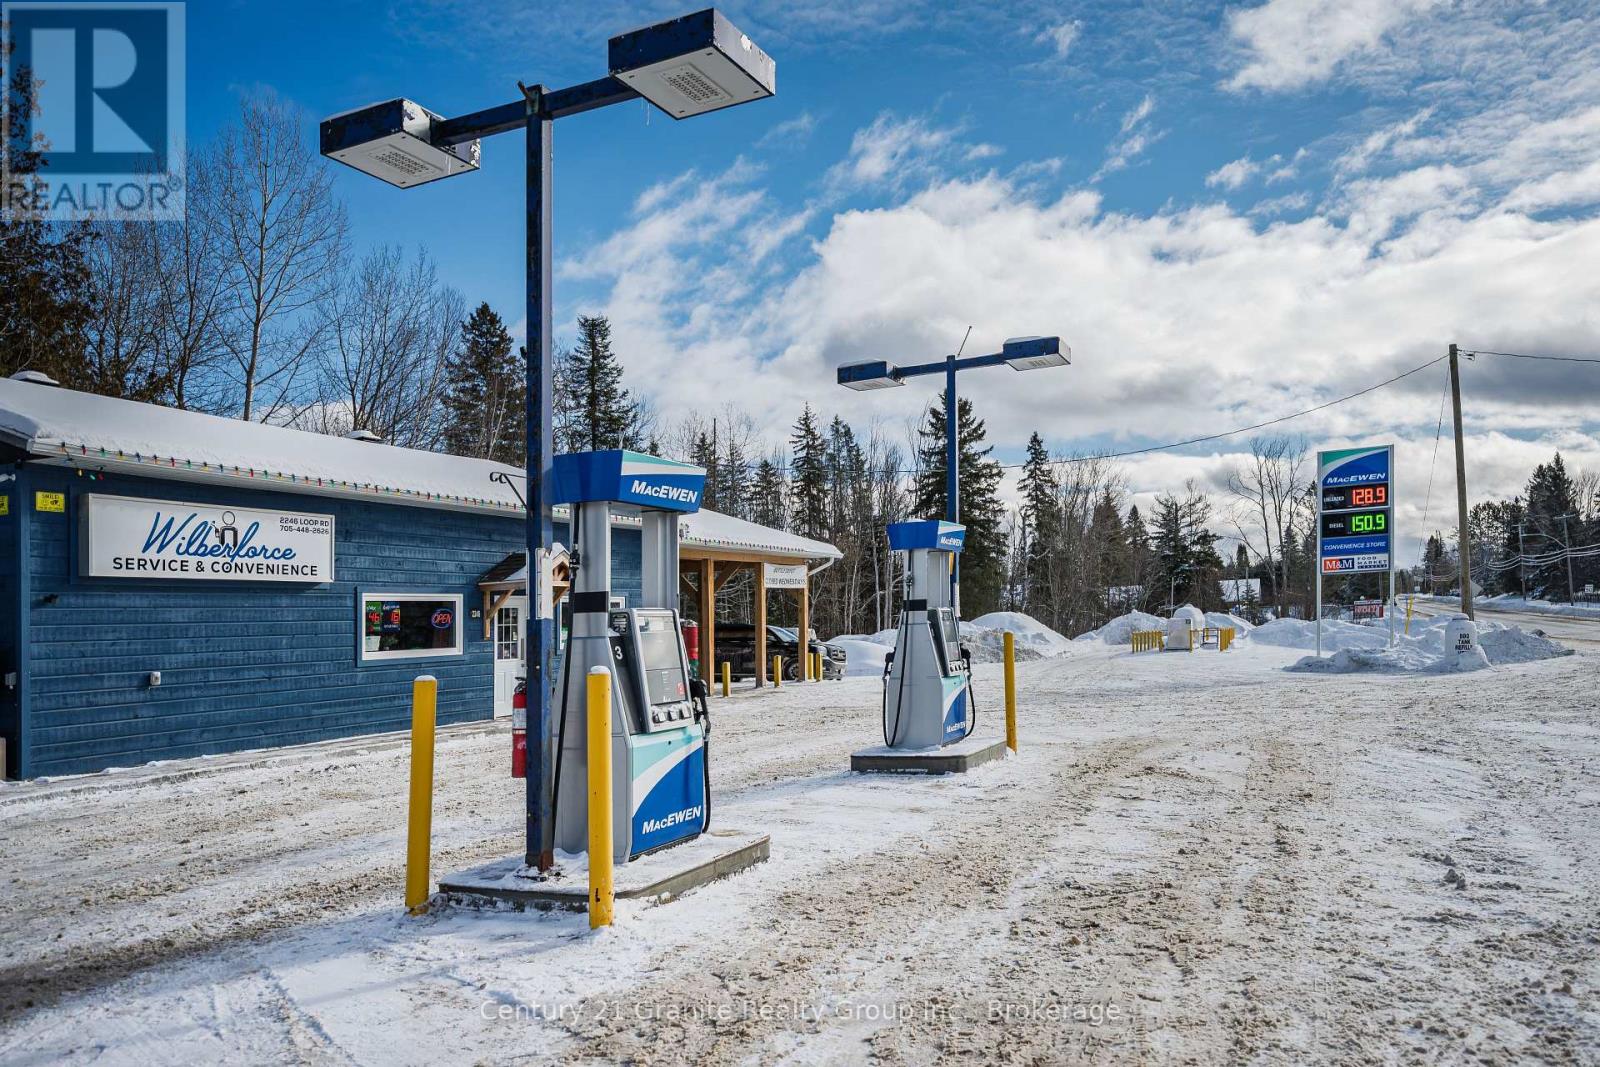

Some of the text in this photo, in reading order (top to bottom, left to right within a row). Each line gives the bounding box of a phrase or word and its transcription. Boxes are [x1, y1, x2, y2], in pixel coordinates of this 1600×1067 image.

[1352, 487, 1386, 505] 128.9
[280, 516, 299, 525] 2246
[300, 518, 319, 526] LOOP
[1352, 514, 1385, 532] 150.9
[141, 511, 297, 562] Wilberforce
[1324, 543, 1365, 551] CONVENIENCE
[113, 557, 318, 576] SERVICE & CONVENIENCE
[1326, 560, 1353, 570] M&M
[434, 613, 451, 624] OPEN
[615, 646, 623, 660] 3
